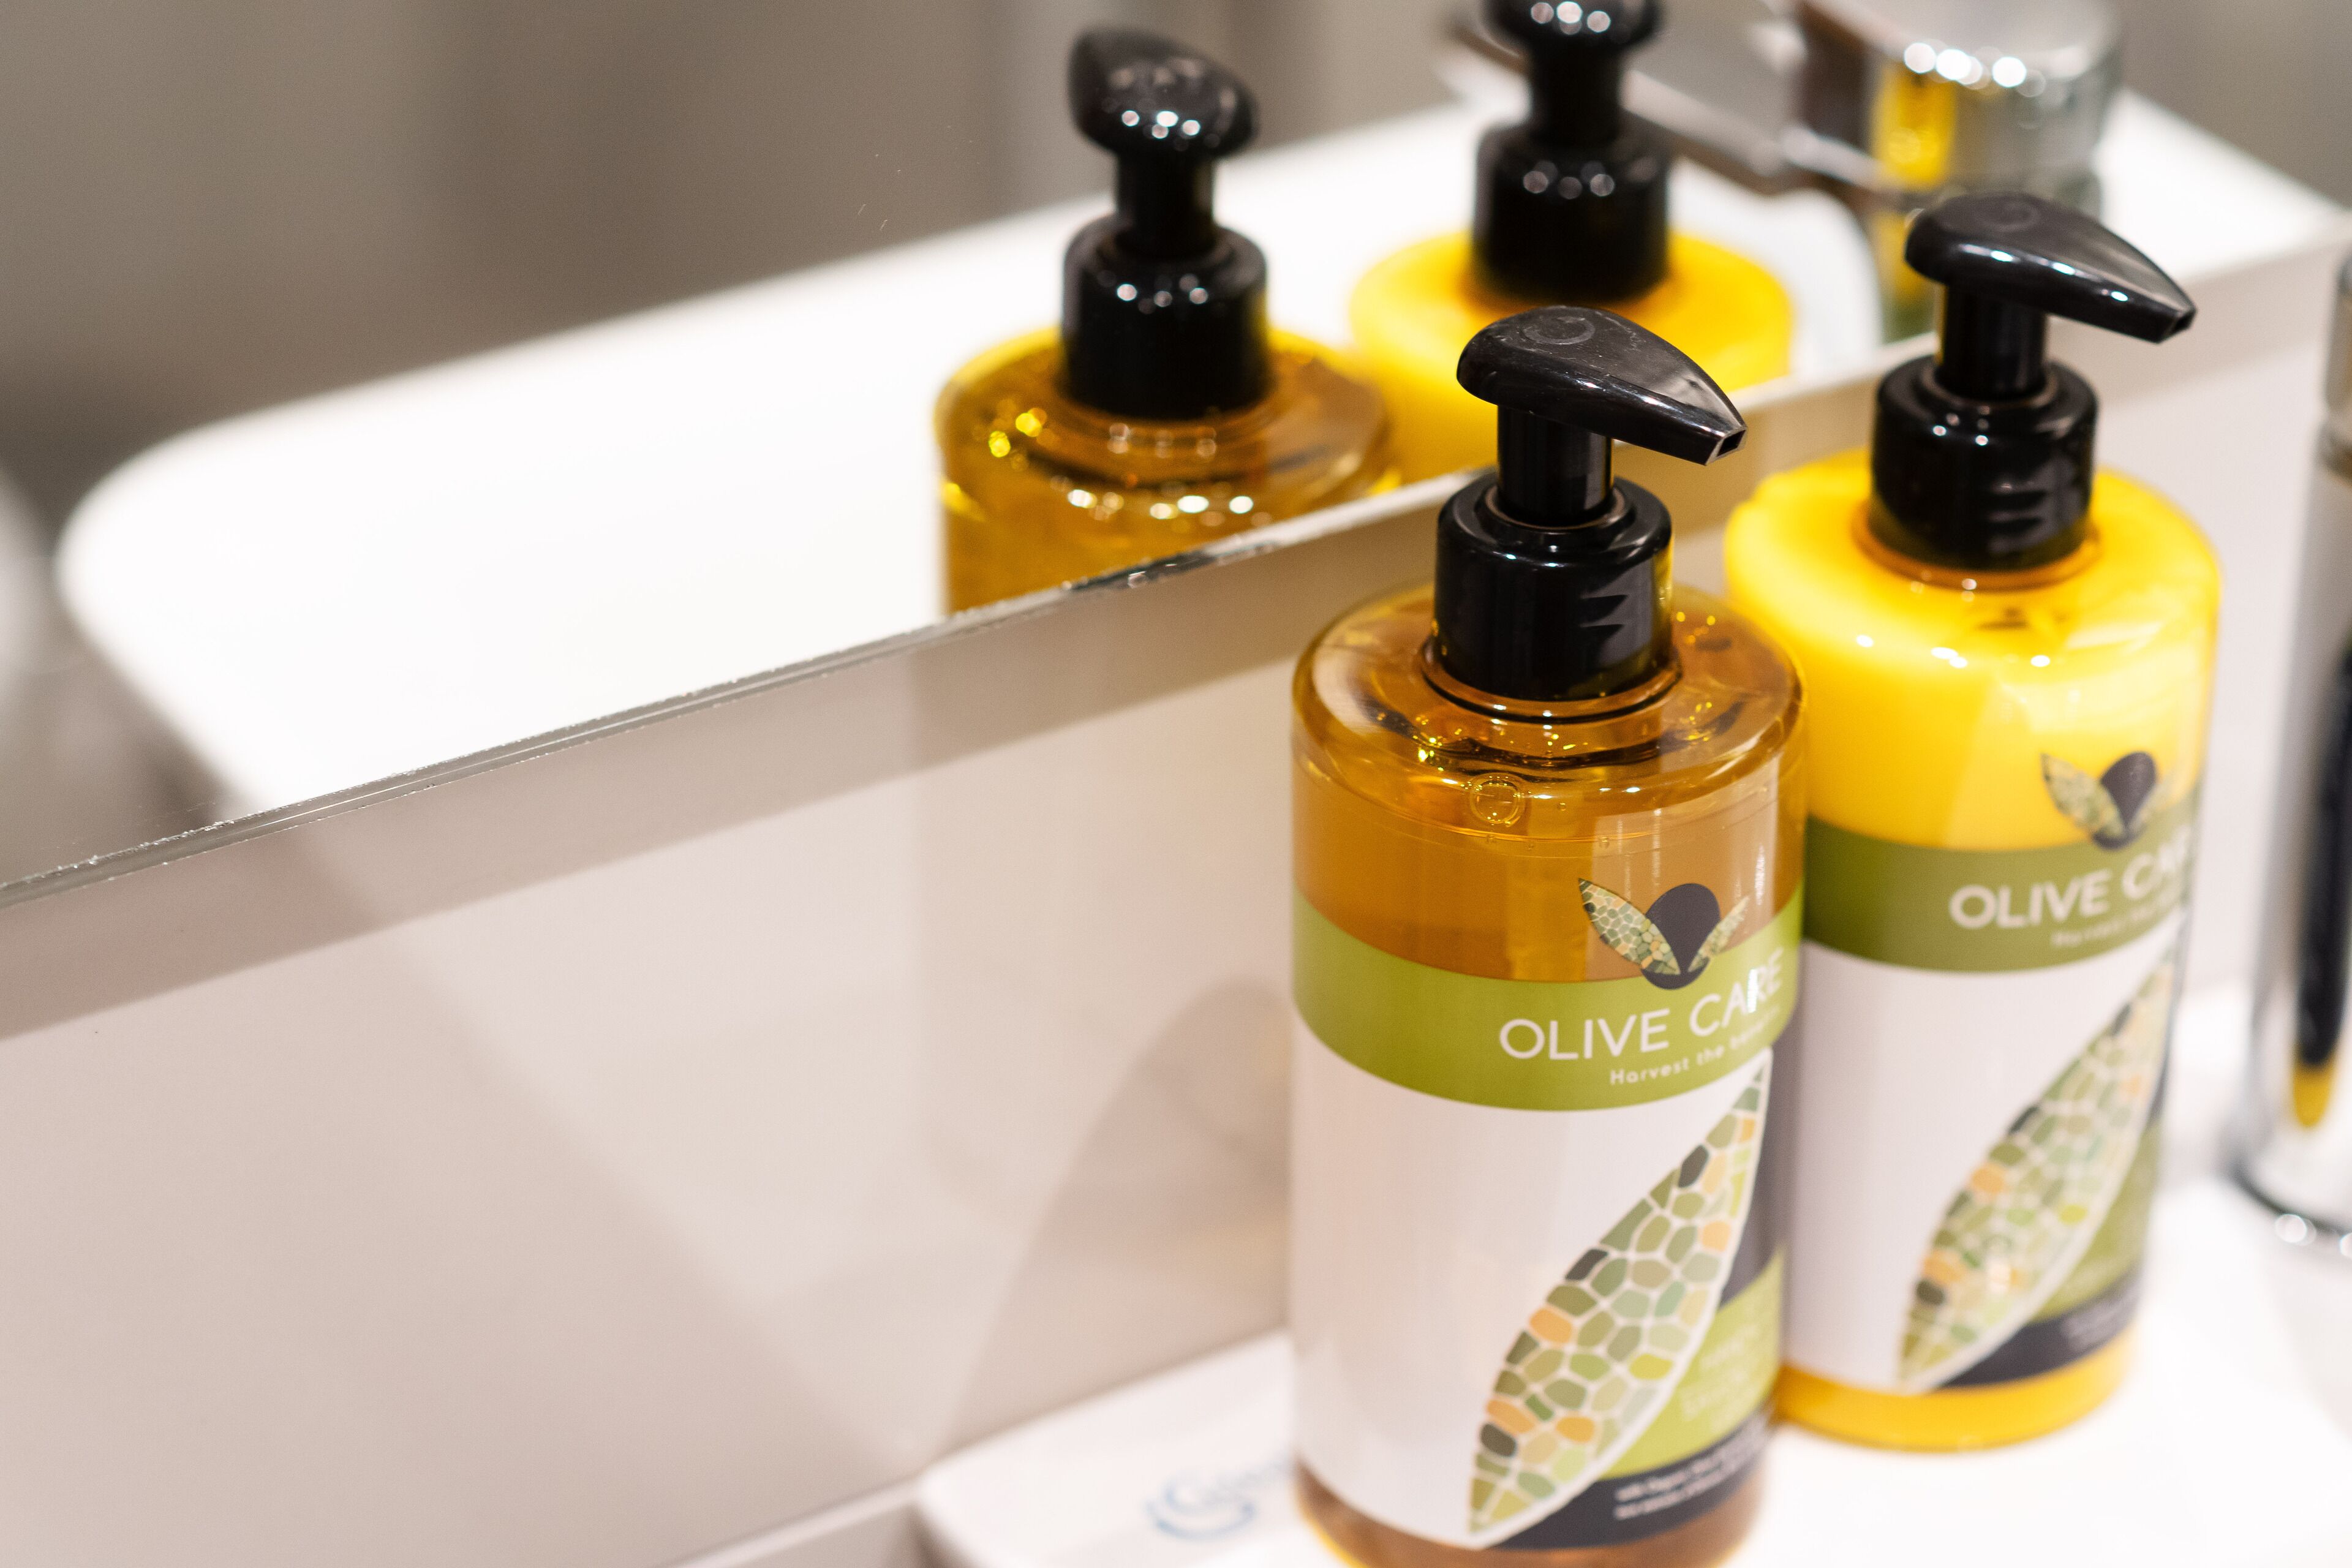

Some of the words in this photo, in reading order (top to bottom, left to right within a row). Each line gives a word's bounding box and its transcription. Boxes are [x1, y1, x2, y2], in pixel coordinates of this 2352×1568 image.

[1948, 868, 2113, 930] OLIVE
[1499, 1008, 1670, 1060] OLIVE
[1610, 1057, 1691, 1085] Harvest
